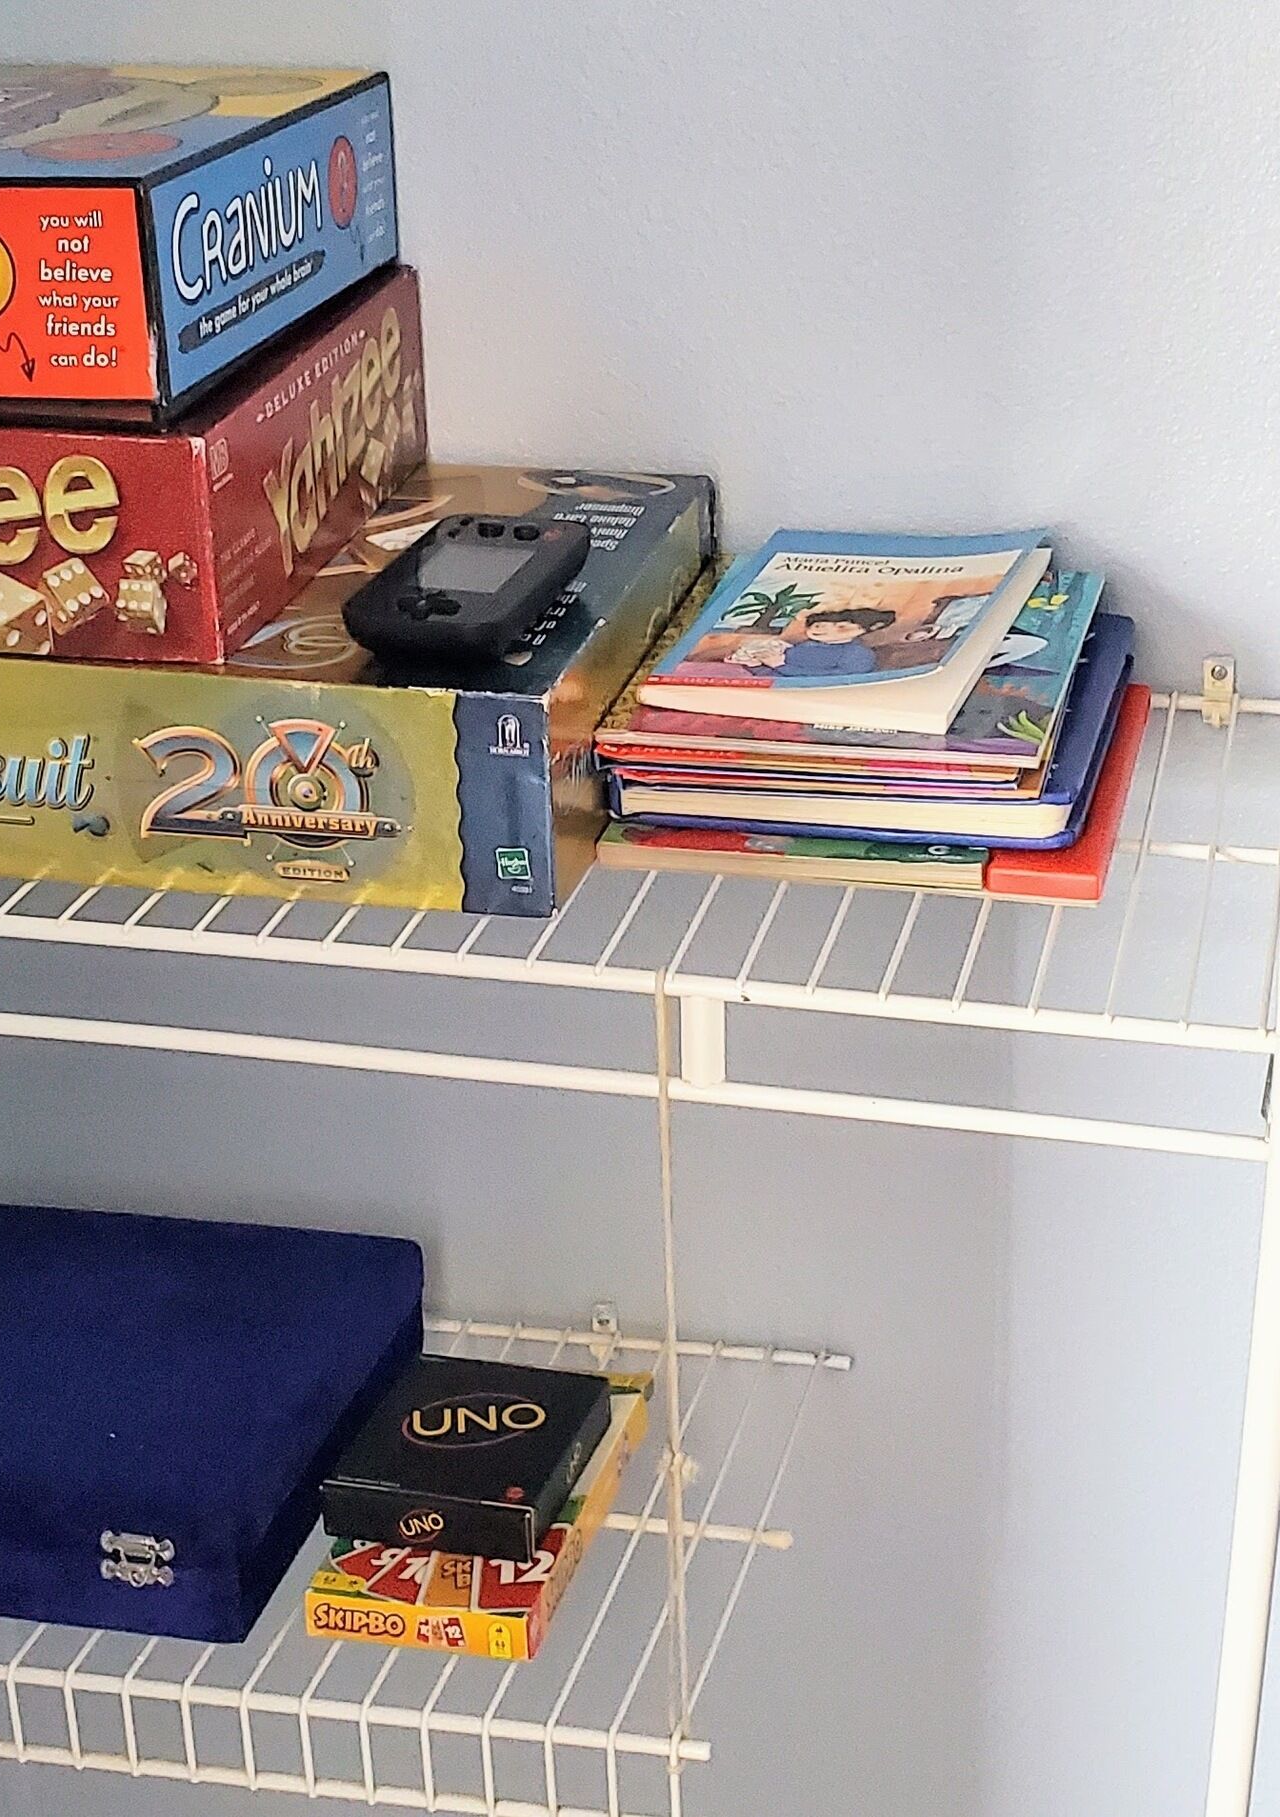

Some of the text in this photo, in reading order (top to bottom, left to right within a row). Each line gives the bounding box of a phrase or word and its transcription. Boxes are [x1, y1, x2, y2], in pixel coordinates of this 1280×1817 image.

[39, 210, 102, 231] you will
[57, 235, 90, 252] not
[40, 259, 112, 282] believe
[38, 290, 119, 312] what your
[199, 316, 213, 338] the
[215, 304, 237, 333] game
[238, 294, 251, 315] for
[251, 287, 269, 312] your
[270, 274, 292, 296] whole
[47, 314, 116, 336] friends
[50, 345, 118, 367] can do!
[265, 331, 359, 418] DELUXE EDITION
[262, 307, 402, 577] Yahtzee
[775, 563, 965, 576] Abuelita Opalina
[242, 806, 378, 837] Anniversary
[281, 865, 345, 879] EDITION
[411, 1402, 547, 1437] UNO
[399, 1512, 444, 1537] UNO
